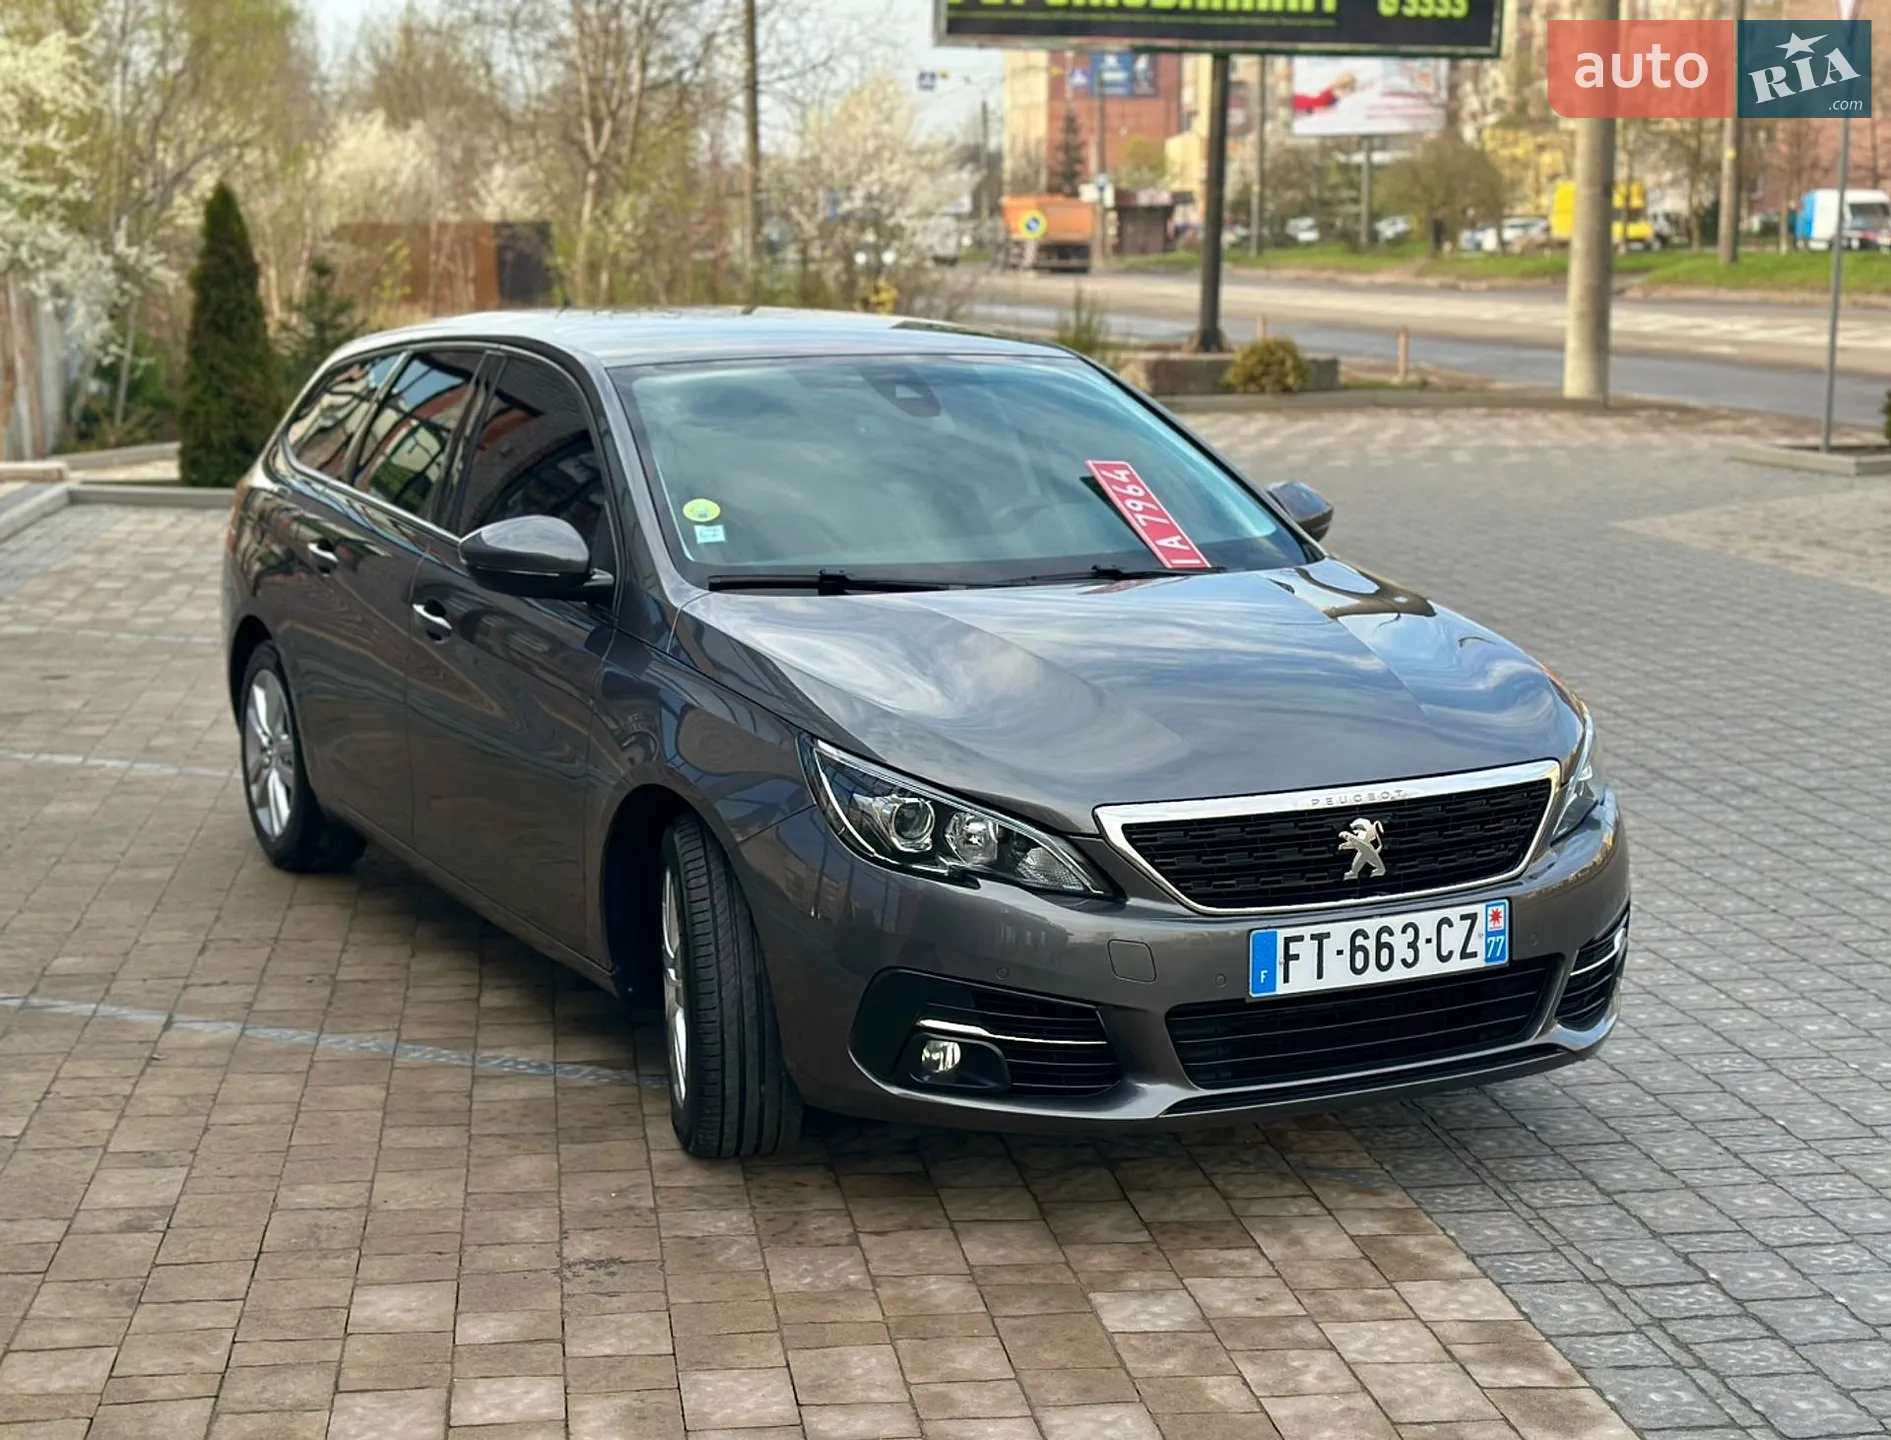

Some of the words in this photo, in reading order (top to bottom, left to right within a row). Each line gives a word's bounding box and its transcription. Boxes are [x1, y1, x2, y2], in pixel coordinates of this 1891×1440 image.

[1311, 789, 1403, 806] PEUGEOT
[1283, 912, 1479, 984] FT-663-CZ
[1487, 935, 1505, 959] 77
[1260, 969, 1269, 984] F
